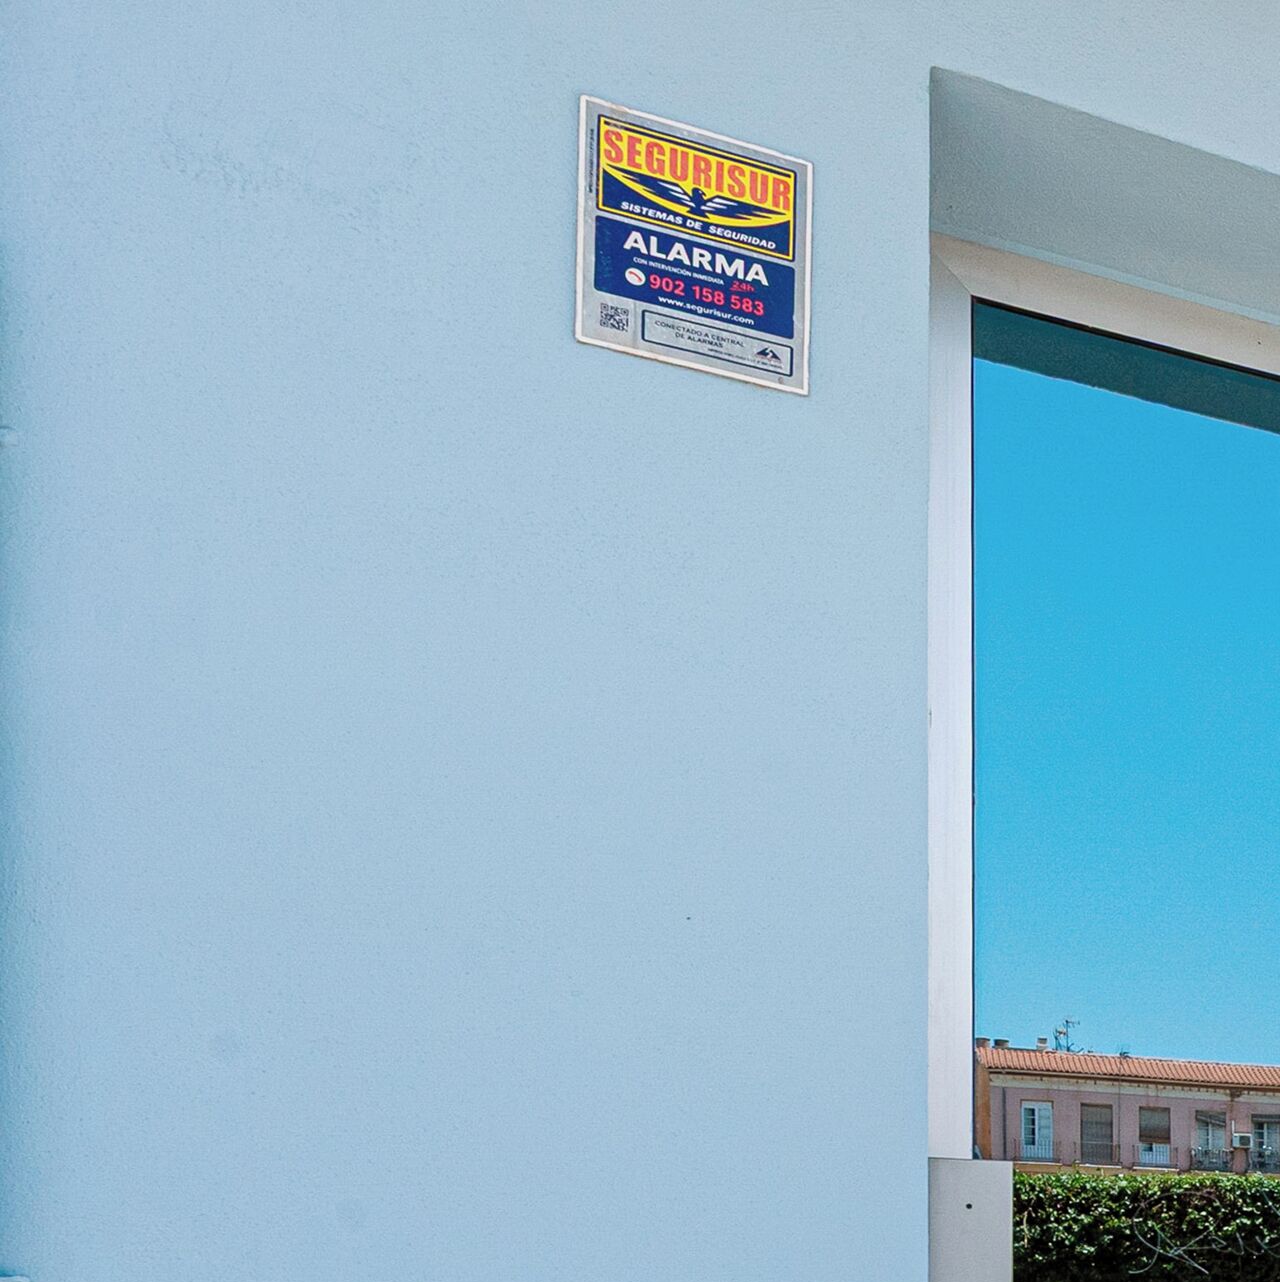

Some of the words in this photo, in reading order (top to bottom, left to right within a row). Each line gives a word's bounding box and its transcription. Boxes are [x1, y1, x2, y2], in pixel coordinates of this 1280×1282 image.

[603, 129, 791, 211] SEGURISUR
[621, 201, 683, 224] SISTEMAS
[686, 217, 703, 231] DE
[709, 225, 776, 250] SEGURIDAD
[623, 230, 769, 287] ALARMA
[633, 256, 648, 266] CON
[730, 280, 755, 293] 24h
[650, 274, 686, 297] 902
[692, 285, 726, 306] 158
[730, 294, 765, 316] 583
[657, 295, 756, 326] www.segurisur.com
[655, 320, 703, 337] CONECTADO
[704, 331, 714, 339] A
[713, 333, 746, 348] CENTRAL
[675, 332, 686, 340] DE
[687, 335, 724, 349] ALARMAS
